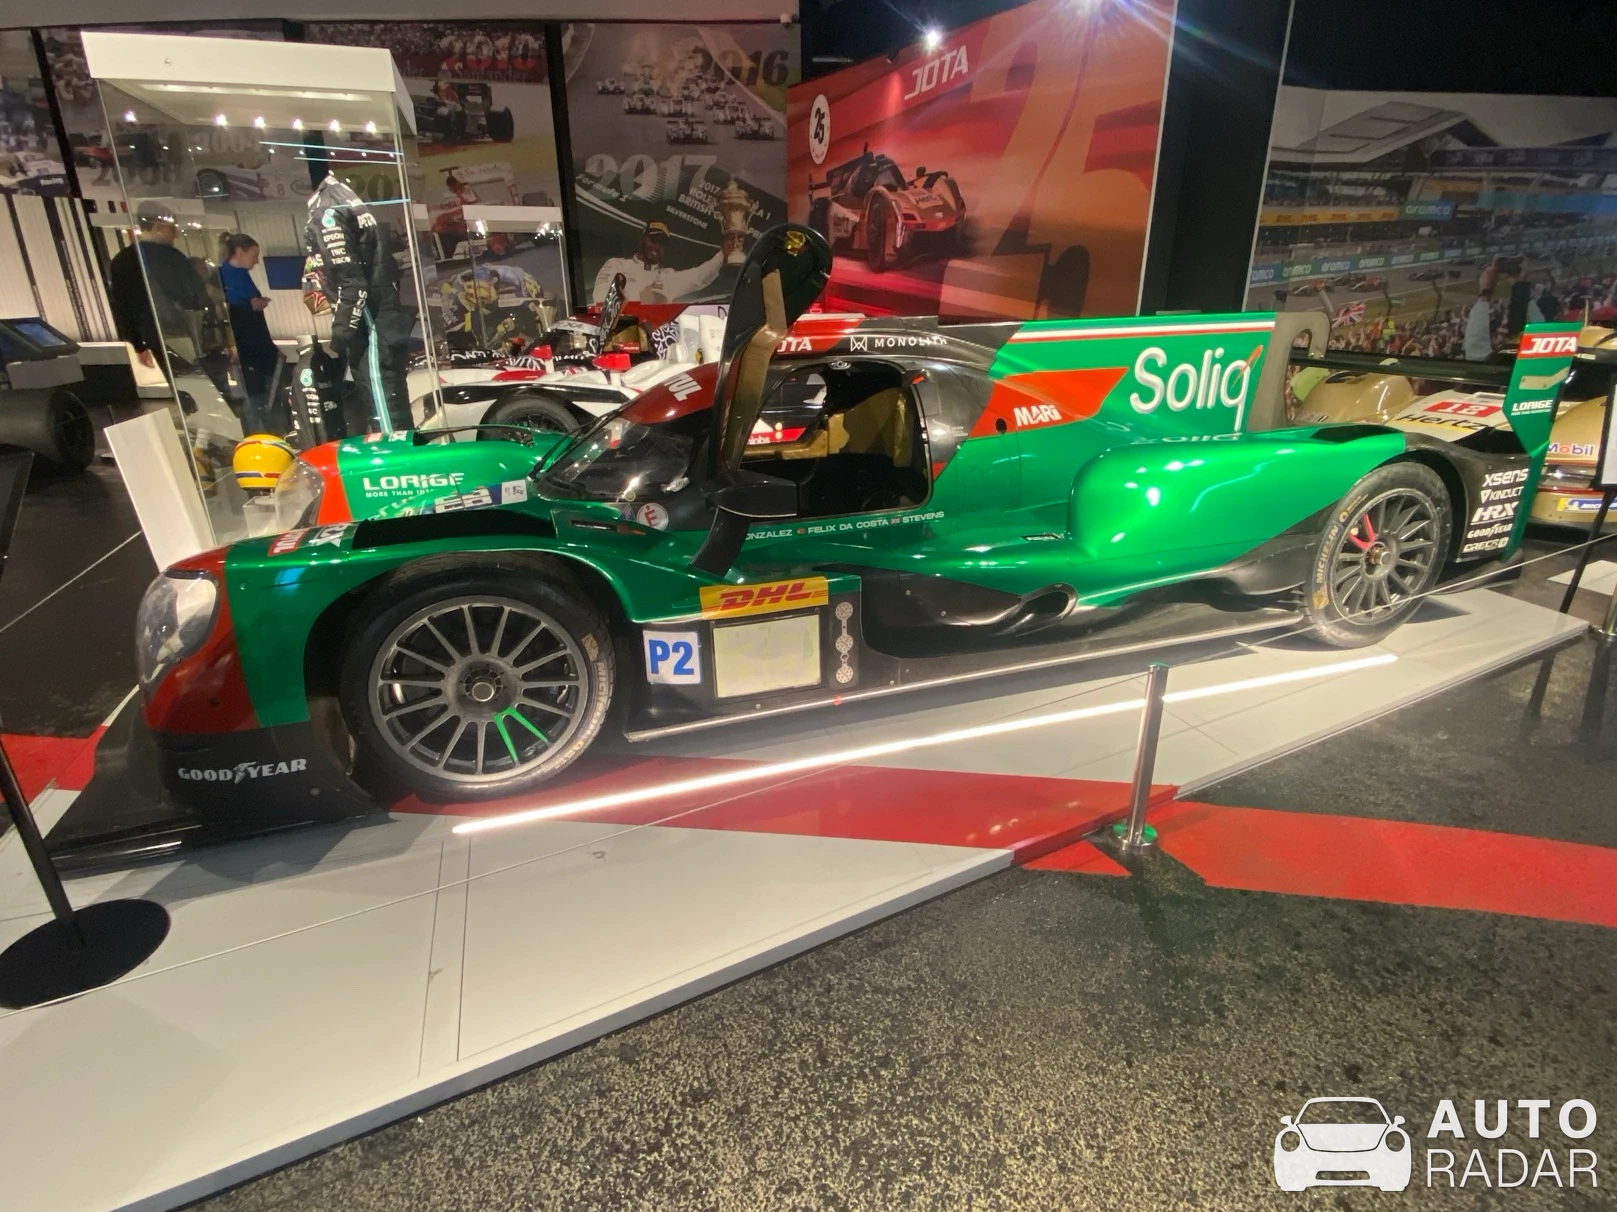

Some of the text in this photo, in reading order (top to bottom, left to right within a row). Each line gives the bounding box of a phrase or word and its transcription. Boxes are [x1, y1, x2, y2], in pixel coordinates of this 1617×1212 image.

[904, 45, 968, 100] JOTA
[814, 107, 825, 144] 25
[585, 153, 717, 201] 2017
[698, 179, 720, 194] 2017
[667, 205, 709, 231] SILVERSTONE
[678, 194, 713, 218] BRITISH
[1404, 203, 1451, 216] aramco
[349, 289, 368, 329] INEOS
[1520, 336, 1577, 354] JOTA
[1130, 344, 1264, 432] Soliq
[1512, 400, 1554, 411] LORIGE
[1547, 444, 1594, 456] Mobil
[363, 472, 465, 491] LORIGE
[391, 489, 413, 497] THAN
[807, 524, 836, 535] FELIX
[839, 522, 853, 531] DA
[856, 518, 889, 529] COSTA
[902, 510, 945, 524] STEVENS
[1471, 501, 1520, 523] HRX
[719, 581, 813, 611] DHL
[648, 639, 695, 675] P2
[177, 758, 307, 784] GOODYEAR
